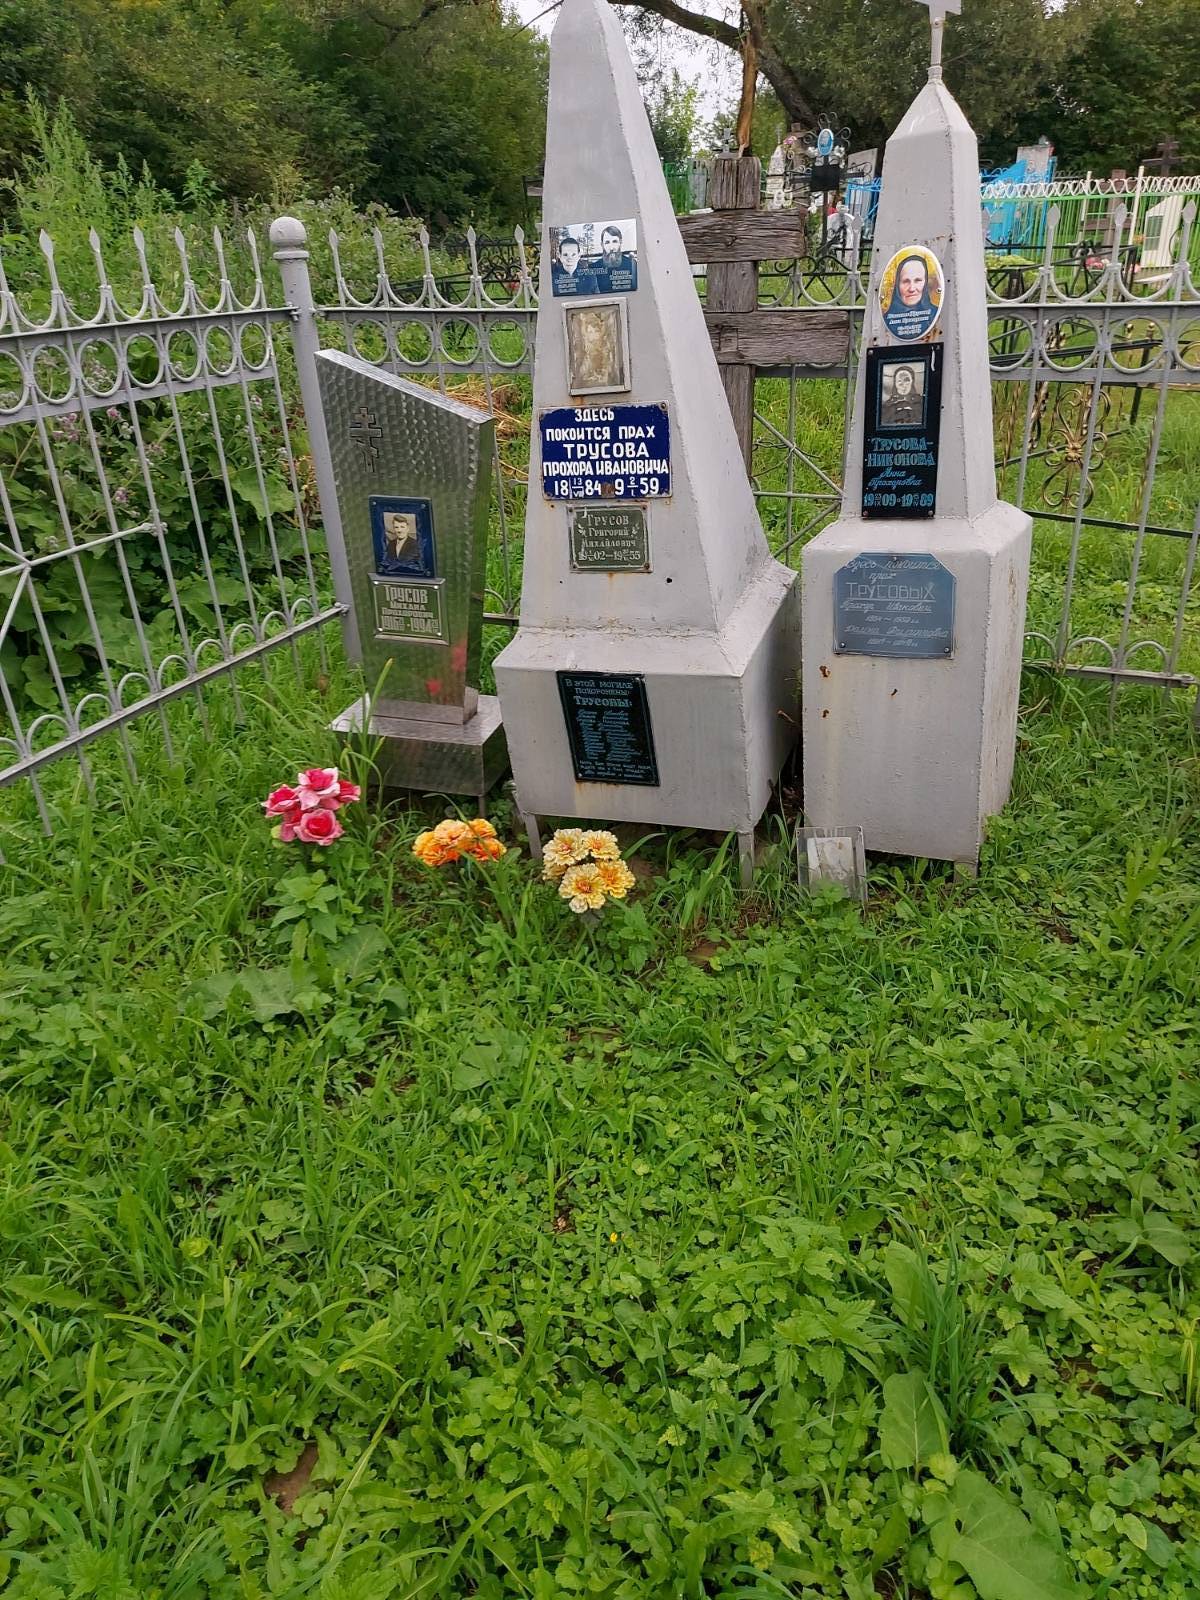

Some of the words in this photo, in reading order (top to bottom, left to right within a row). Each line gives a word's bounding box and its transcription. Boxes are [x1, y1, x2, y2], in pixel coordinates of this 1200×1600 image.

[574, 408, 615, 422] ЗДЕСЬ
[546, 426, 610, 441] ПОКОИТСЯ
[618, 425, 655, 440] ПРАХ
[562, 442, 649, 459] ТРУСОВА
[867, 452, 935, 466] НИКОНОВА
[543, 461, 594, 476] ПРОХОРА
[595, 459, 669, 475] ИВАНОВИЧА
[384, 585, 428, 603] ТРУСОВ
